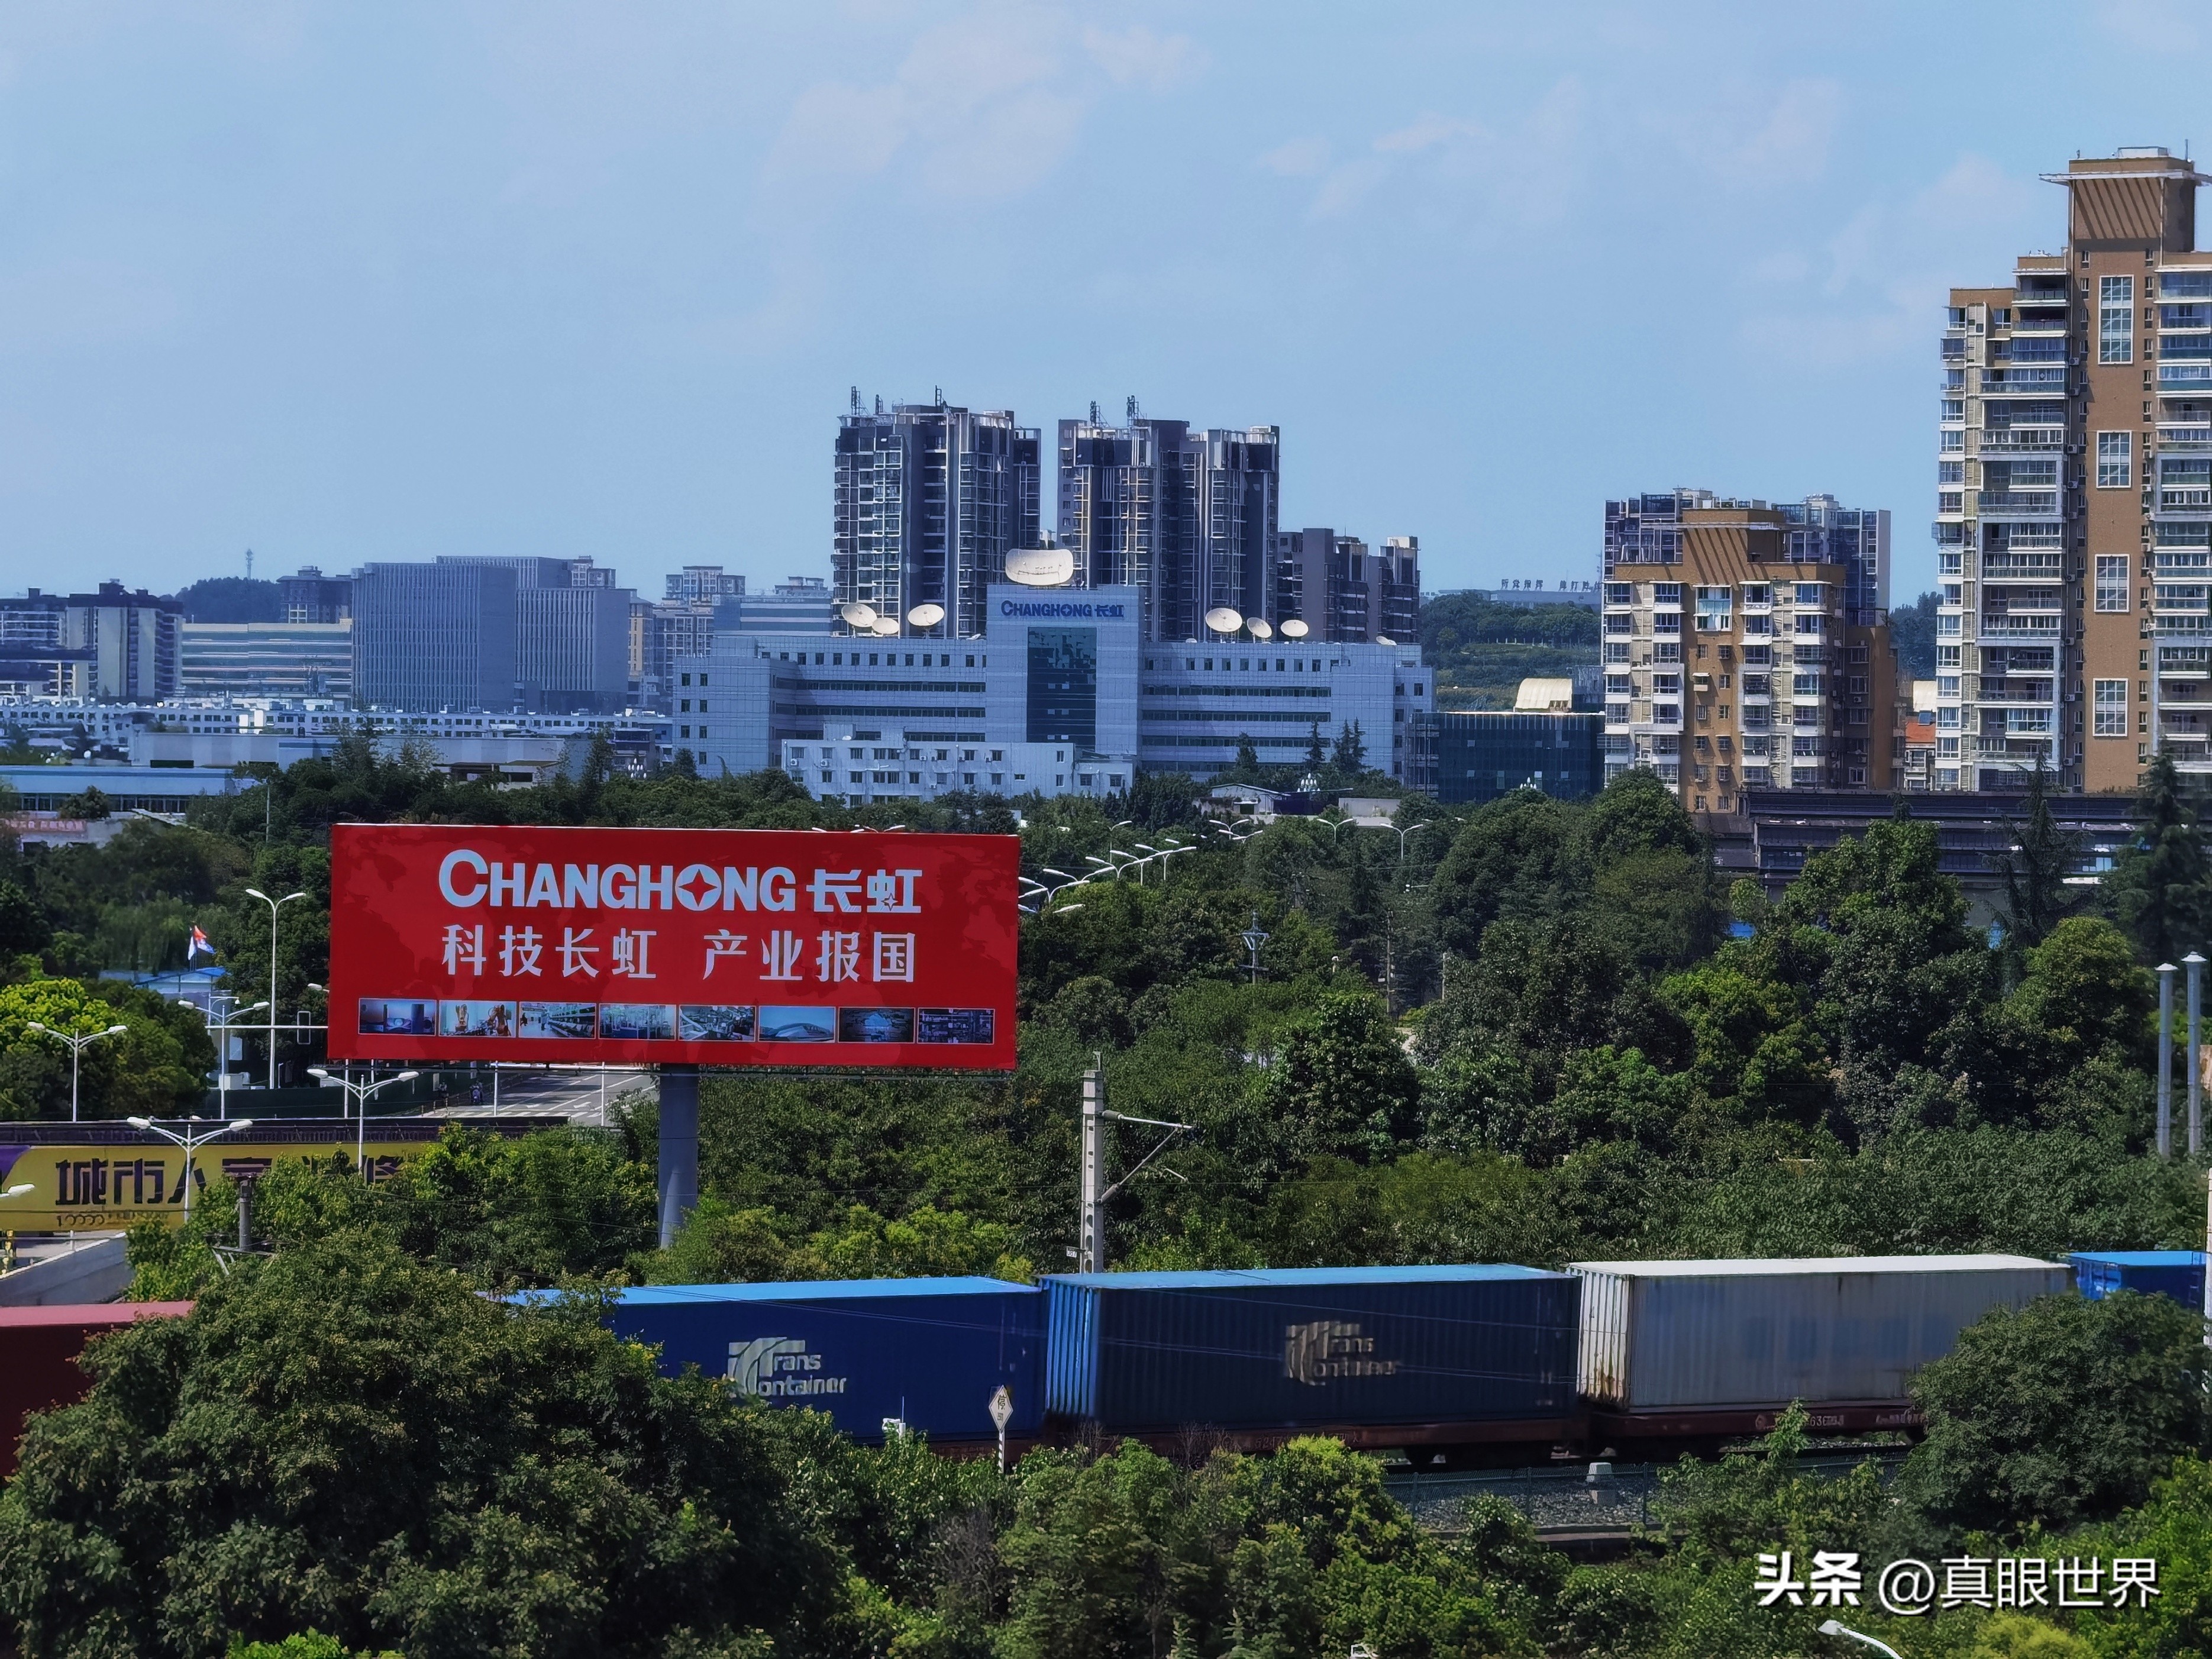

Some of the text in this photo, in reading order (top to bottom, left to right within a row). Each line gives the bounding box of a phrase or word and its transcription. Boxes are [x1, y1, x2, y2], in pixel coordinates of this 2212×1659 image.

[1001, 600, 1124, 618] CHANGHONG 长虹
[438, 848, 923, 914] CHANGHONG 长虹
[441, 923, 916, 983] 科技长虹 产业报国
